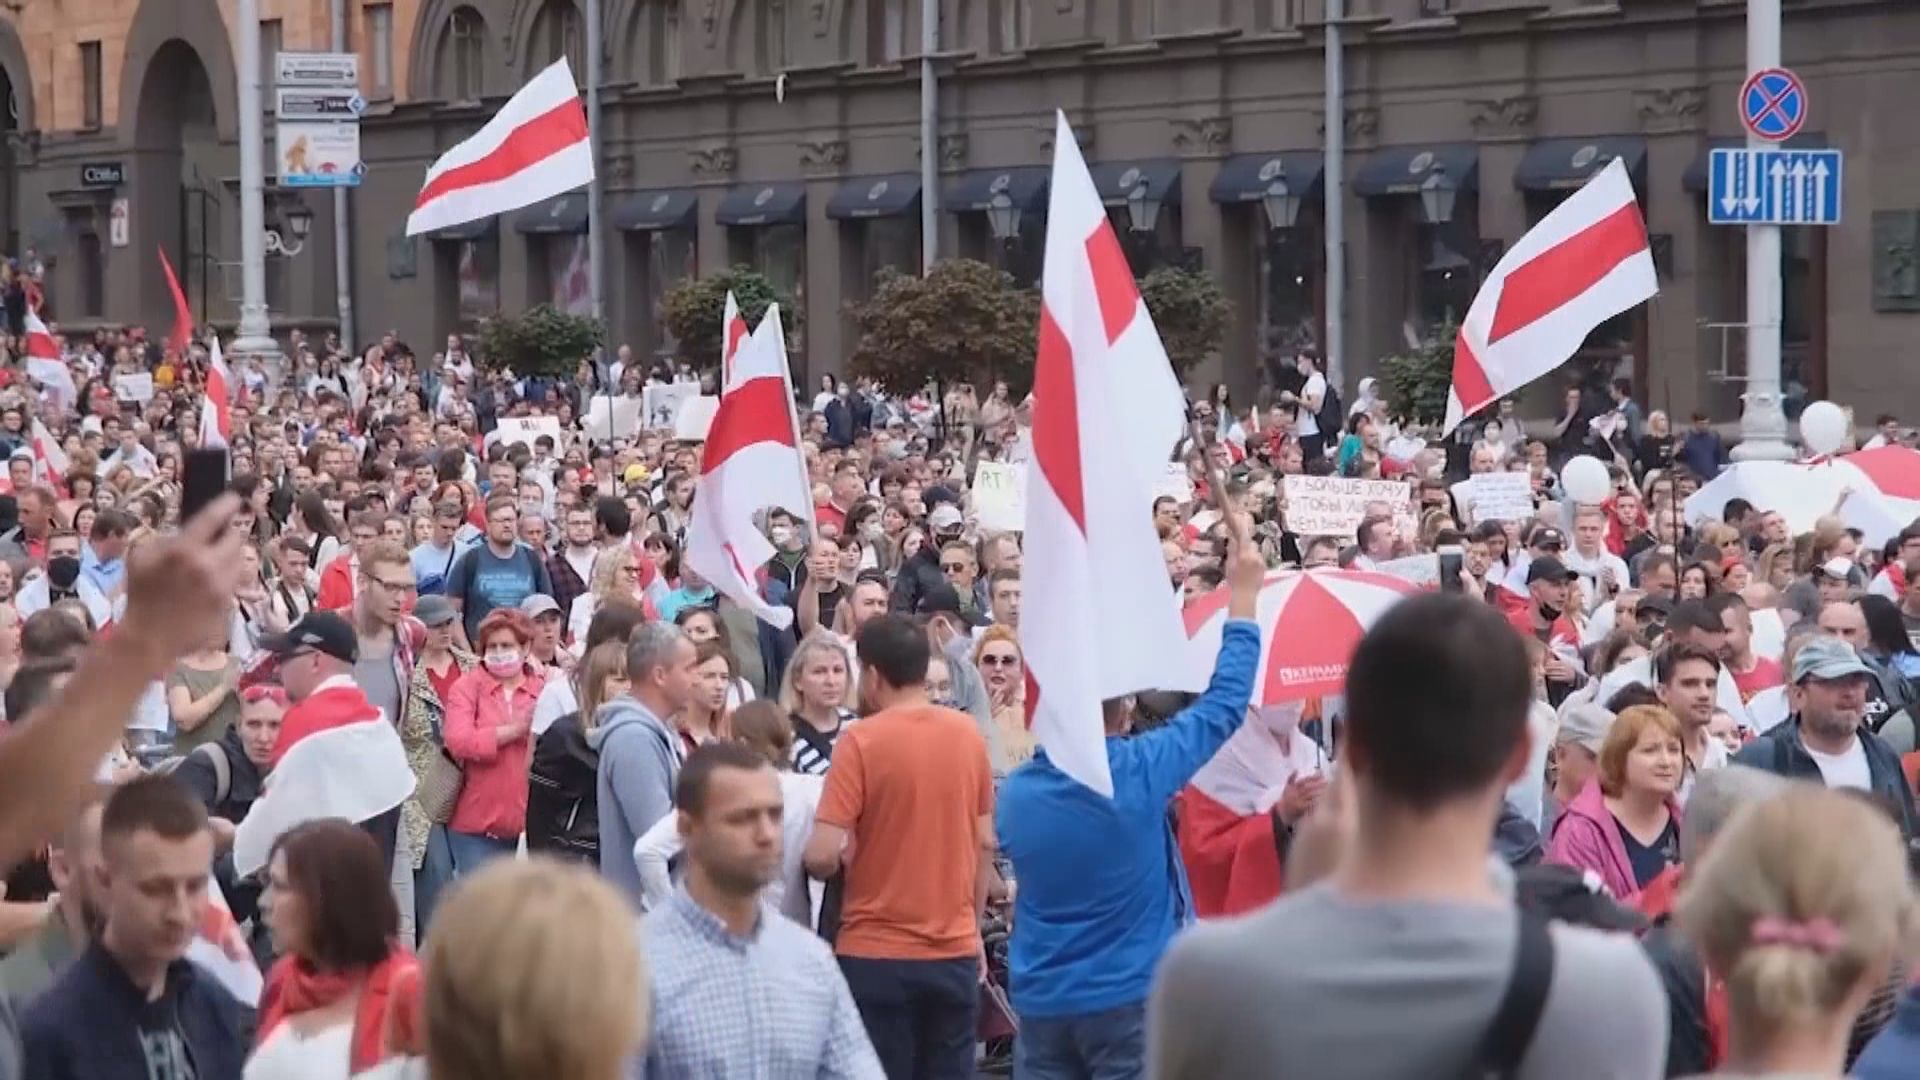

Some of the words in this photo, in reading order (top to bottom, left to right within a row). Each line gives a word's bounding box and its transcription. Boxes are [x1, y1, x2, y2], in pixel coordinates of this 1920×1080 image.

[1305, 479, 1361, 495] БОЛЬШЕ
[1368, 482, 1405, 497] ХОЧУ
[1289, 496, 1342, 513] ЧТОБЫ
